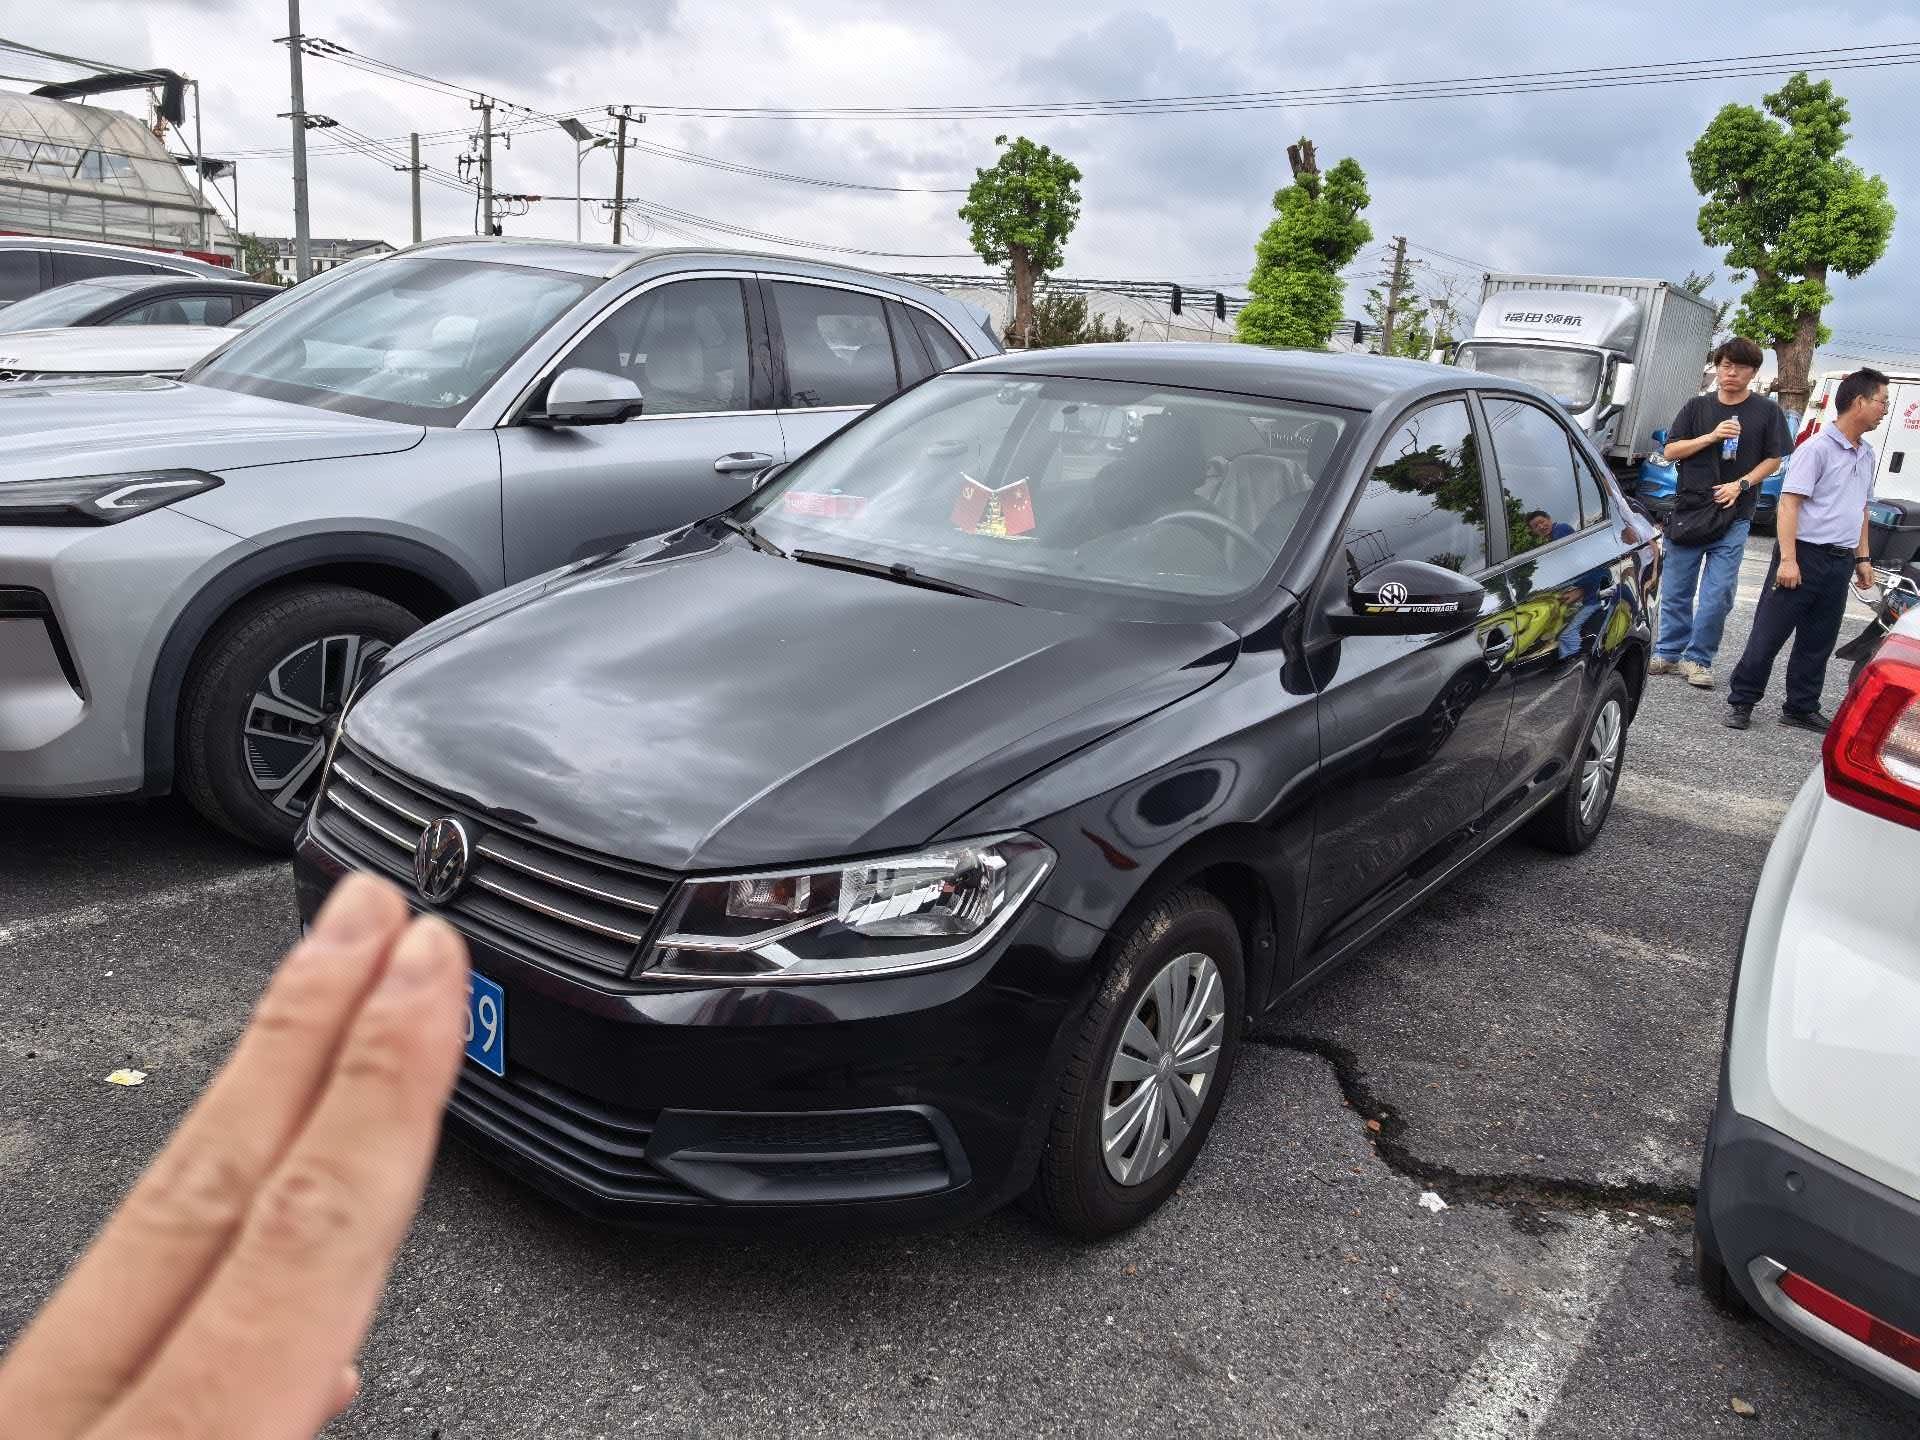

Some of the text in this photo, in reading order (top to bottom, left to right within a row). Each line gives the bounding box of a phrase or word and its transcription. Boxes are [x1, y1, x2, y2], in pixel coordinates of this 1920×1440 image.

[1504, 312, 1583, 326] 福田领航
[1412, 605, 1458, 613] VOLKSWAGEN
